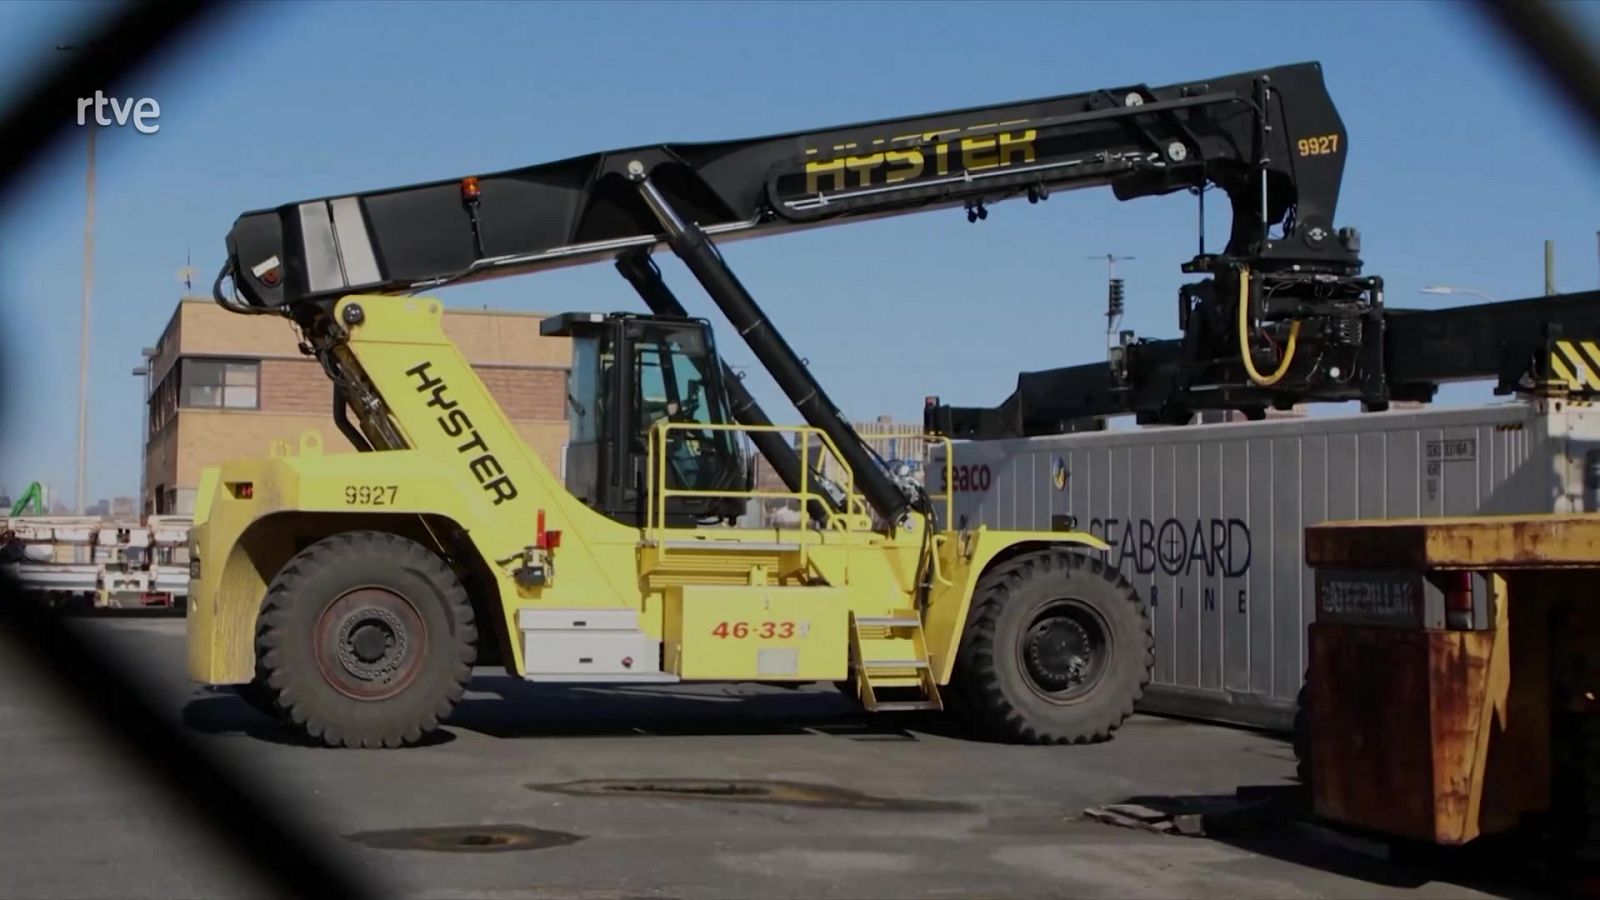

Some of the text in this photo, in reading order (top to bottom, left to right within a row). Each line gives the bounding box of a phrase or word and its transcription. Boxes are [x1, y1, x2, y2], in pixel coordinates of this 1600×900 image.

[1298, 134, 1338, 156] 9927
[406, 361, 518, 506] HYSTER
[345, 485, 399, 505] 9927
[711, 621, 796, 640] 46-33
